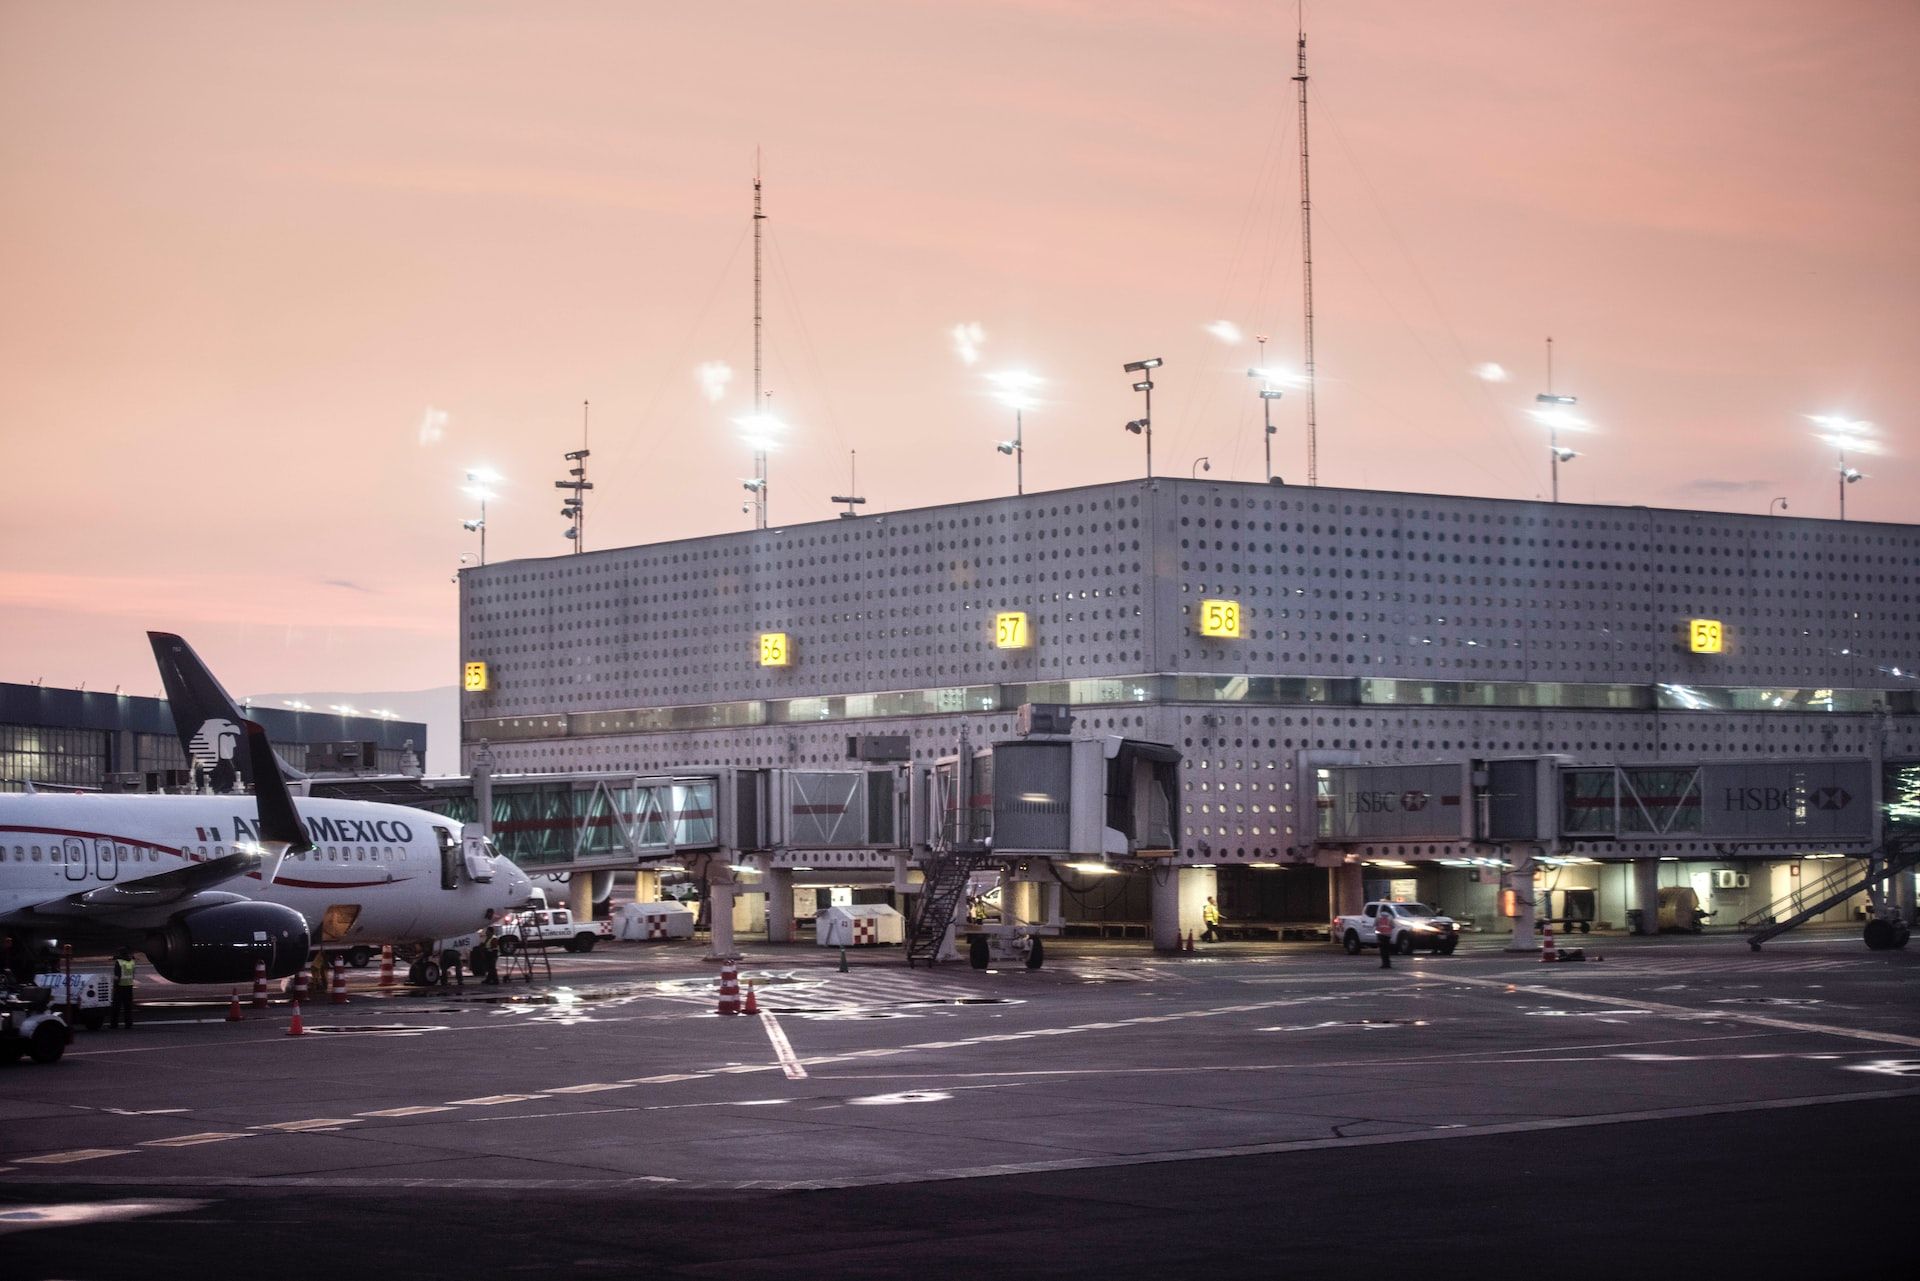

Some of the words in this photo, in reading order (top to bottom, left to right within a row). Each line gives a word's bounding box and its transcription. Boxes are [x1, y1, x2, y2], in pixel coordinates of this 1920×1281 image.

[1000, 617, 1019, 642] 57
[1210, 606, 1235, 631] 58
[1697, 624, 1717, 648] 59
[764, 639, 781, 660] 56
[1349, 791, 1396, 812] HSBC
[1725, 787, 1799, 811] HSBC
[233, 816, 413, 843] AMEXICO
[453, 937, 471, 947] AMS
